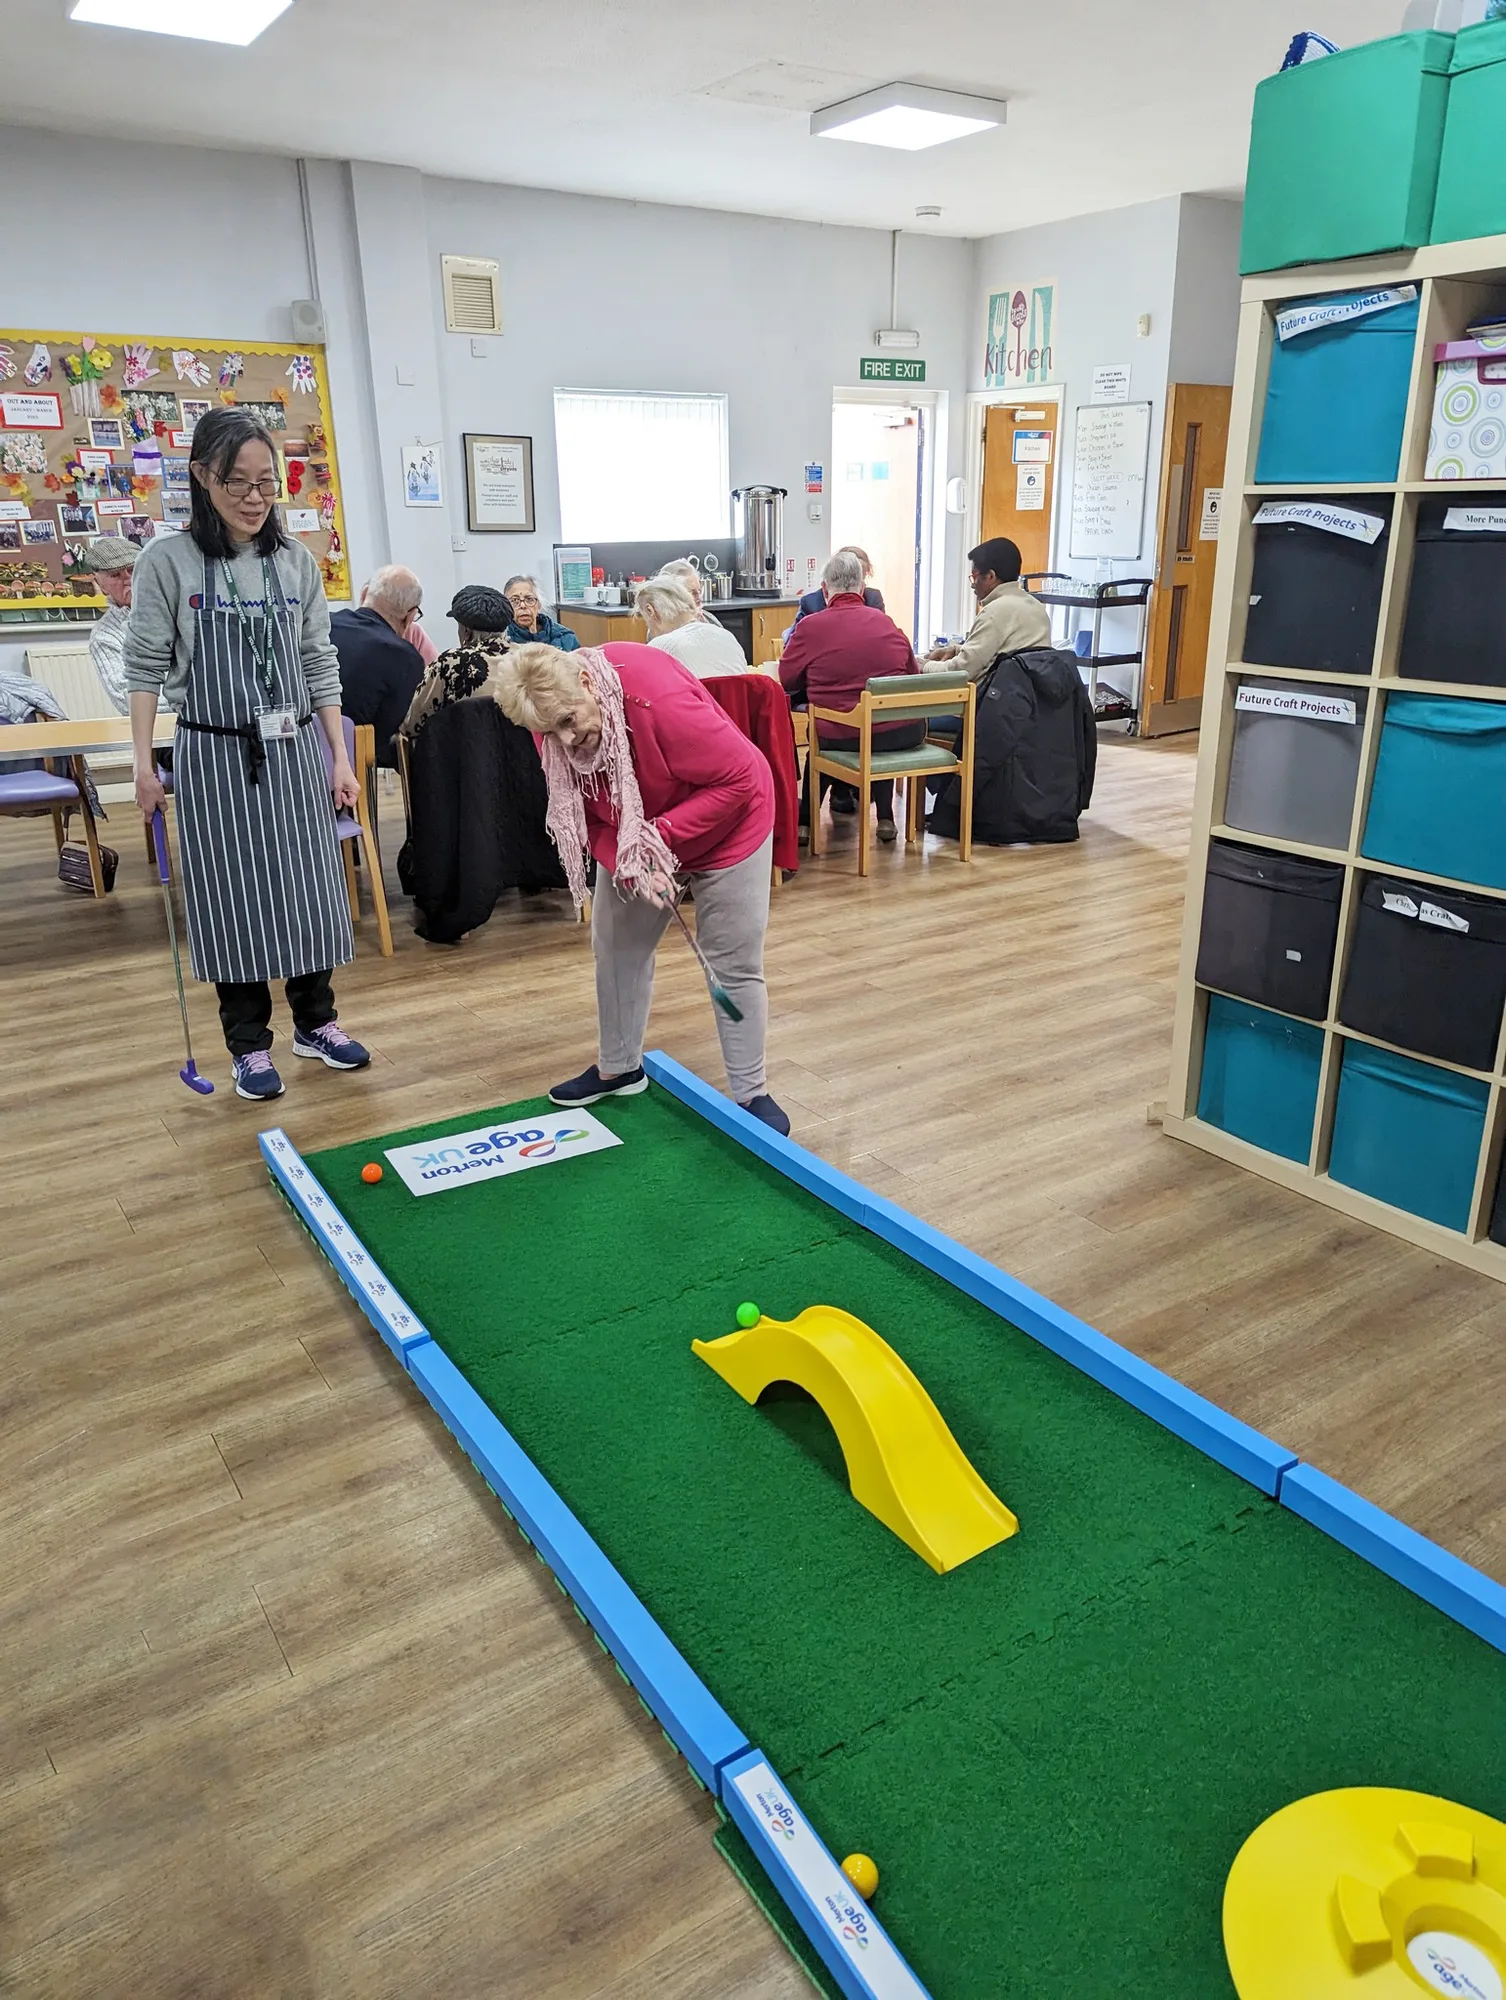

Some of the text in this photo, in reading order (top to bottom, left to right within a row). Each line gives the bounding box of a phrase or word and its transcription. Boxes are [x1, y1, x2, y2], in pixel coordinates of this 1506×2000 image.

[1281, 315, 1307, 332] Future
[1338, 292, 1390, 315] ojects
[864, 362, 921, 378] FIRE EXIT
[984, 343, 1052, 377] Kitchen
[1260, 507, 1358, 532] Future Craft Projects
[1465, 515, 1487, 523] More
[233, 594, 247, 624] VOLUNTEER
[247, 635, 263, 666] VOLUNTEER
[1239, 692, 1341, 716] Future Craft Projects
[411, 1129, 545, 1169] age UK
[421, 1154, 505, 1180] Merton
[756, 1792, 774, 1817] Merton
[774, 1802, 794, 1826] age
[825, 1896, 845, 1924] Merton
[844, 1906, 867, 1933] age
[1433, 1963, 1462, 1990] age
